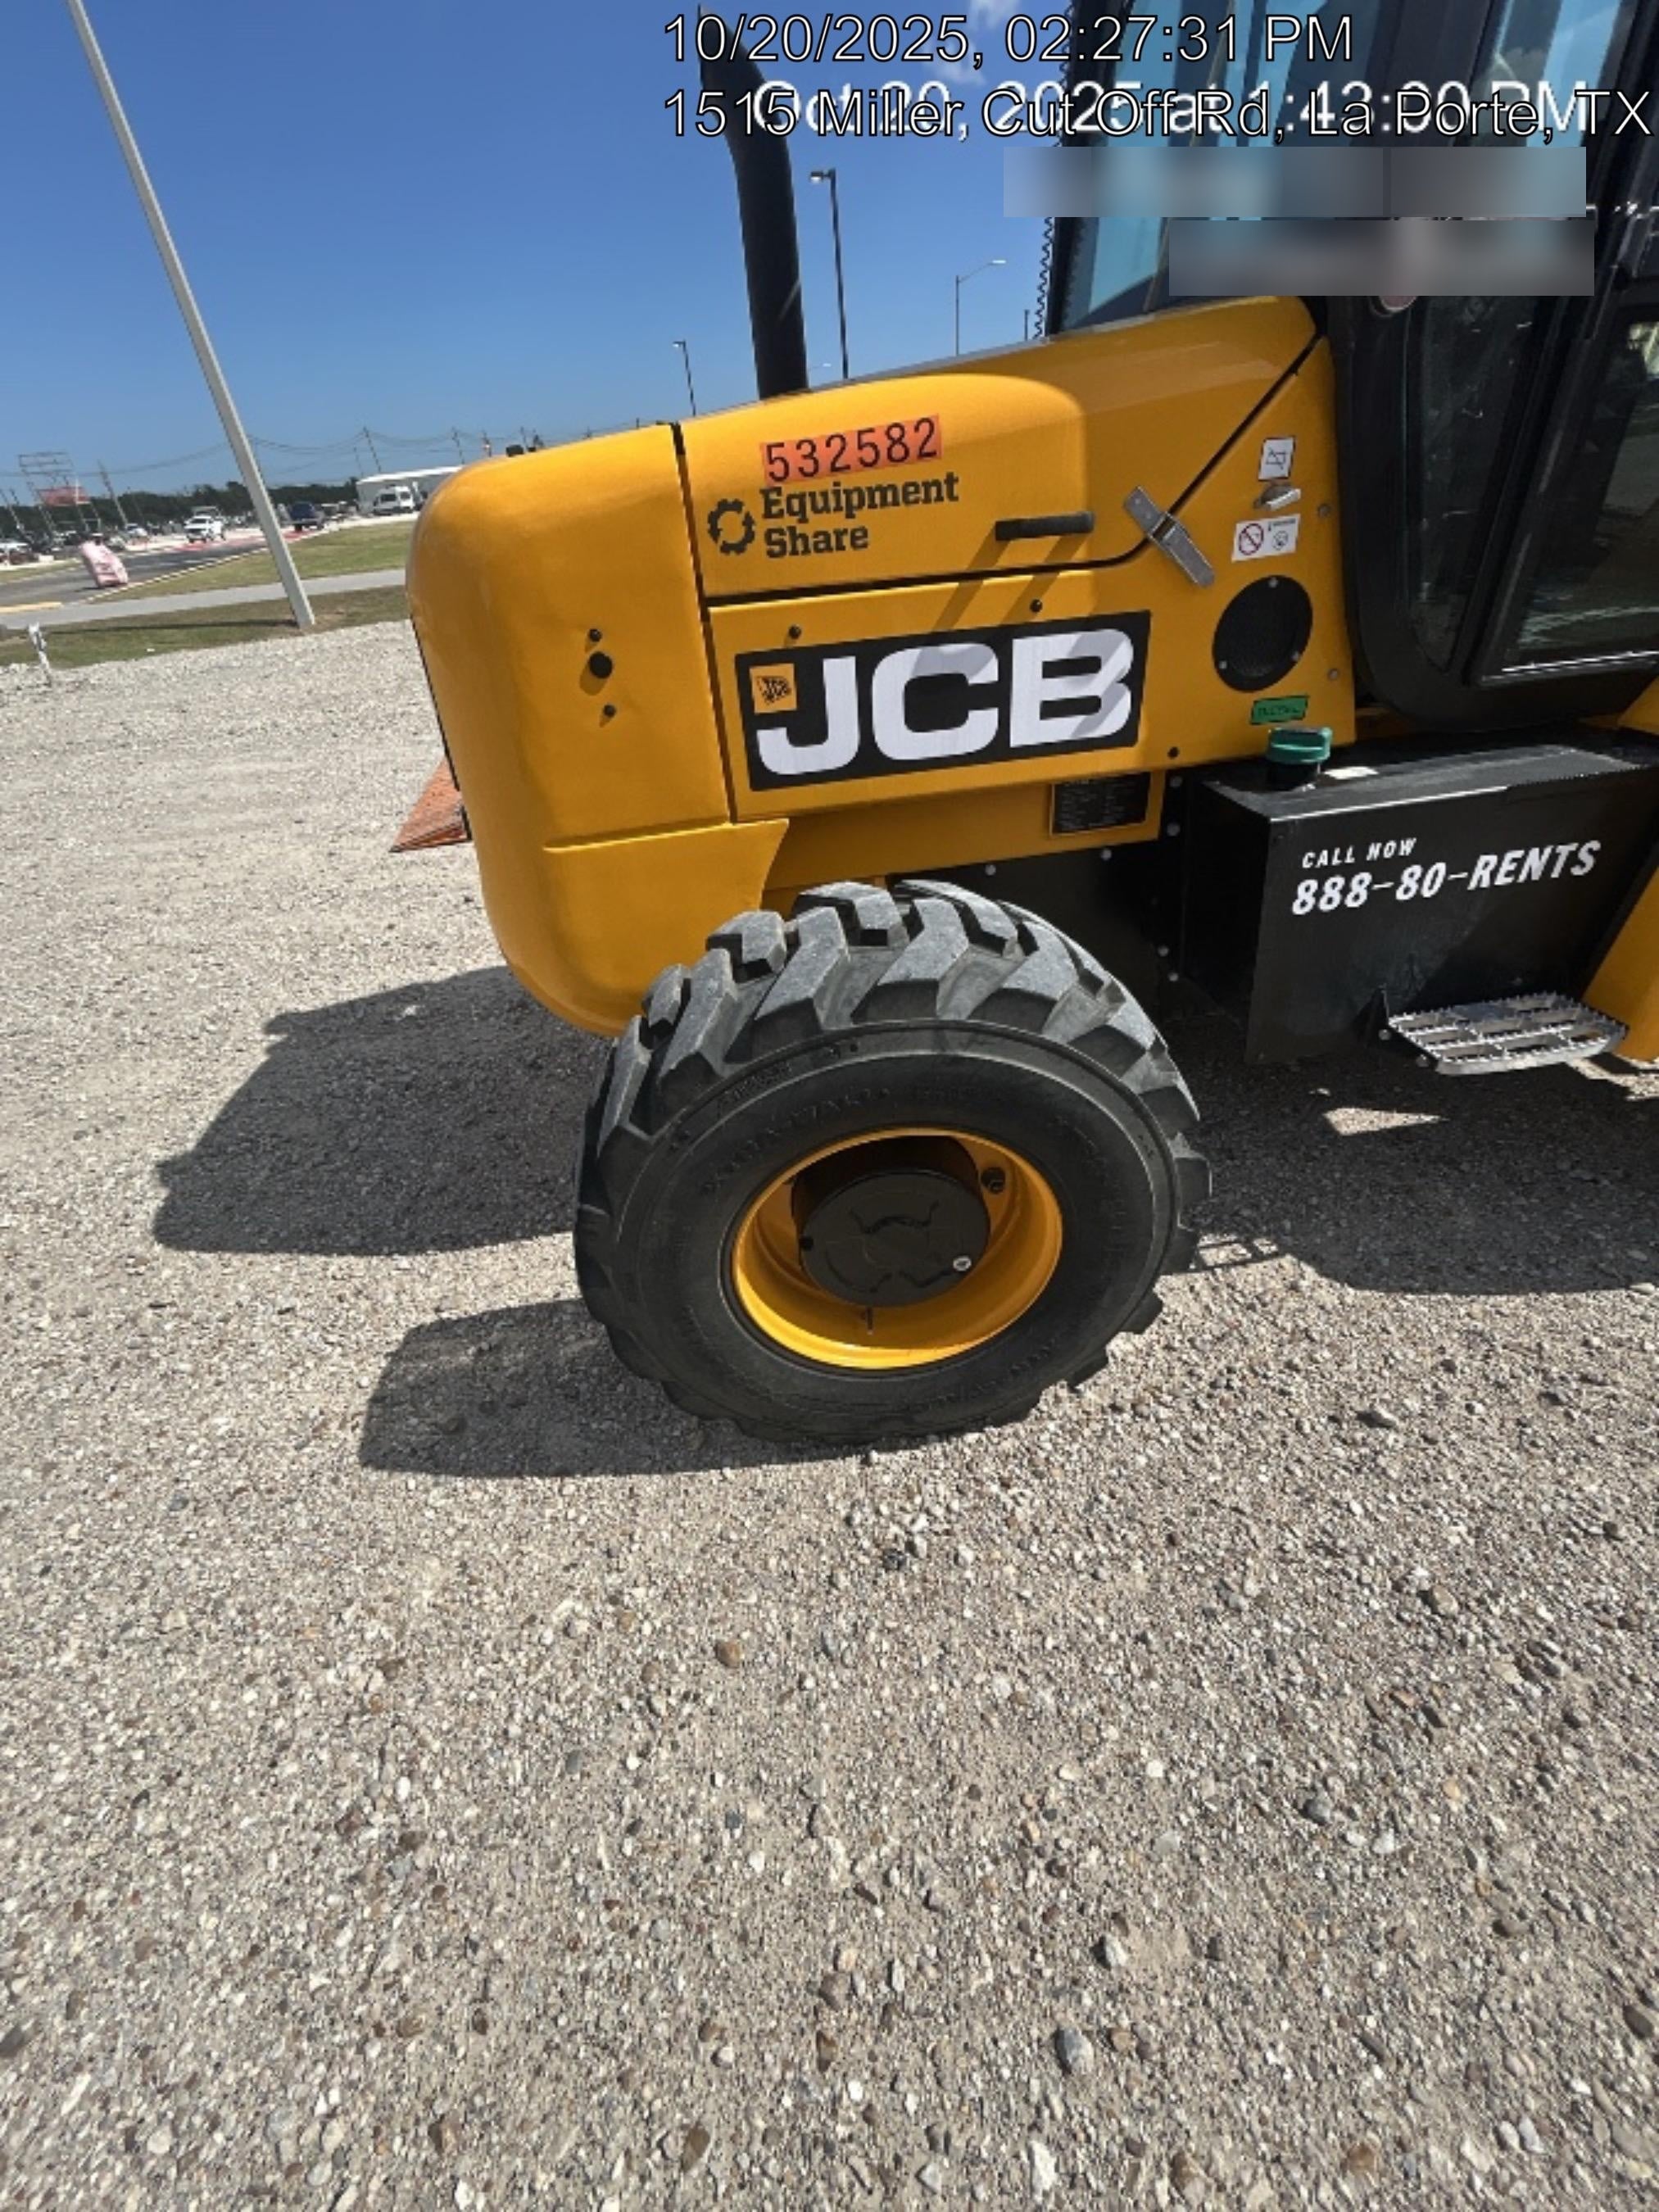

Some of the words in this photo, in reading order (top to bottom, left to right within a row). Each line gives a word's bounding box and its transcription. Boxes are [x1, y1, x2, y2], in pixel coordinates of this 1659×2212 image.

[765, 416, 938, 483] 532582
[759, 471, 959, 524] Equipment
[764, 525, 868, 559] Share
[755, 628, 1135, 776] JCB
[1291, 839, 1602, 916] 888-80-RENTS
[1302, 845, 1356, 869] CALL
[1366, 837, 1417, 862] NOW
